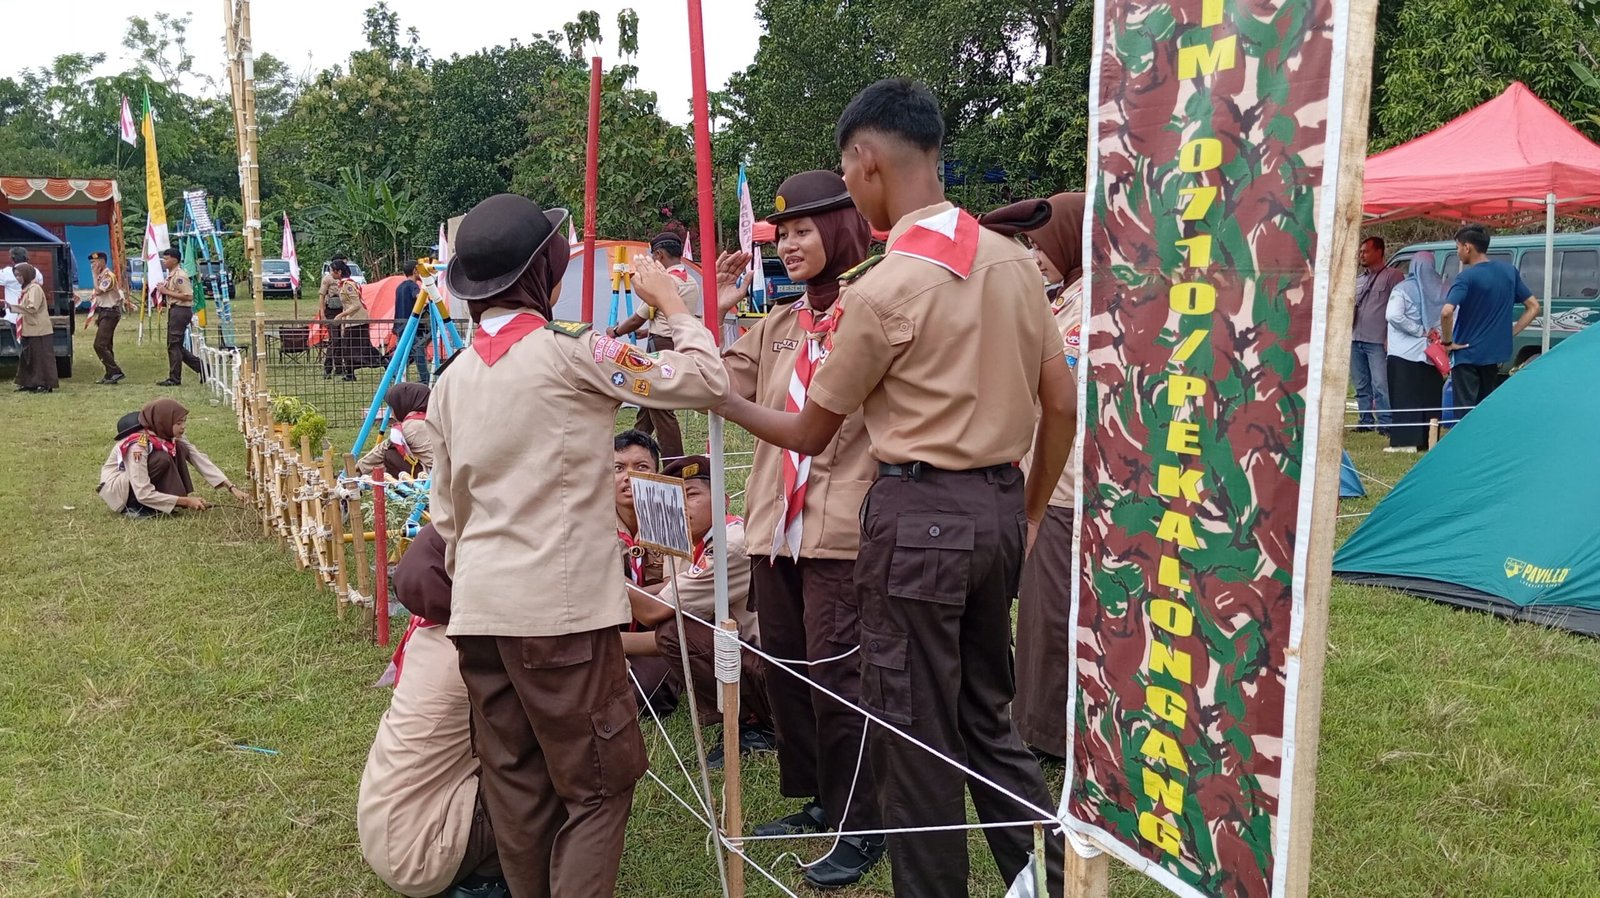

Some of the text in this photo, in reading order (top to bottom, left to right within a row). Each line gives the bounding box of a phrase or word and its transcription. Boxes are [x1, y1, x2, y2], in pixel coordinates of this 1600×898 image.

[777, 284, 807, 292] RESCU
[1138, 137, 1223, 858] 0710/PEKALONGANG
[1521, 563, 1569, 584] PAVILLO
